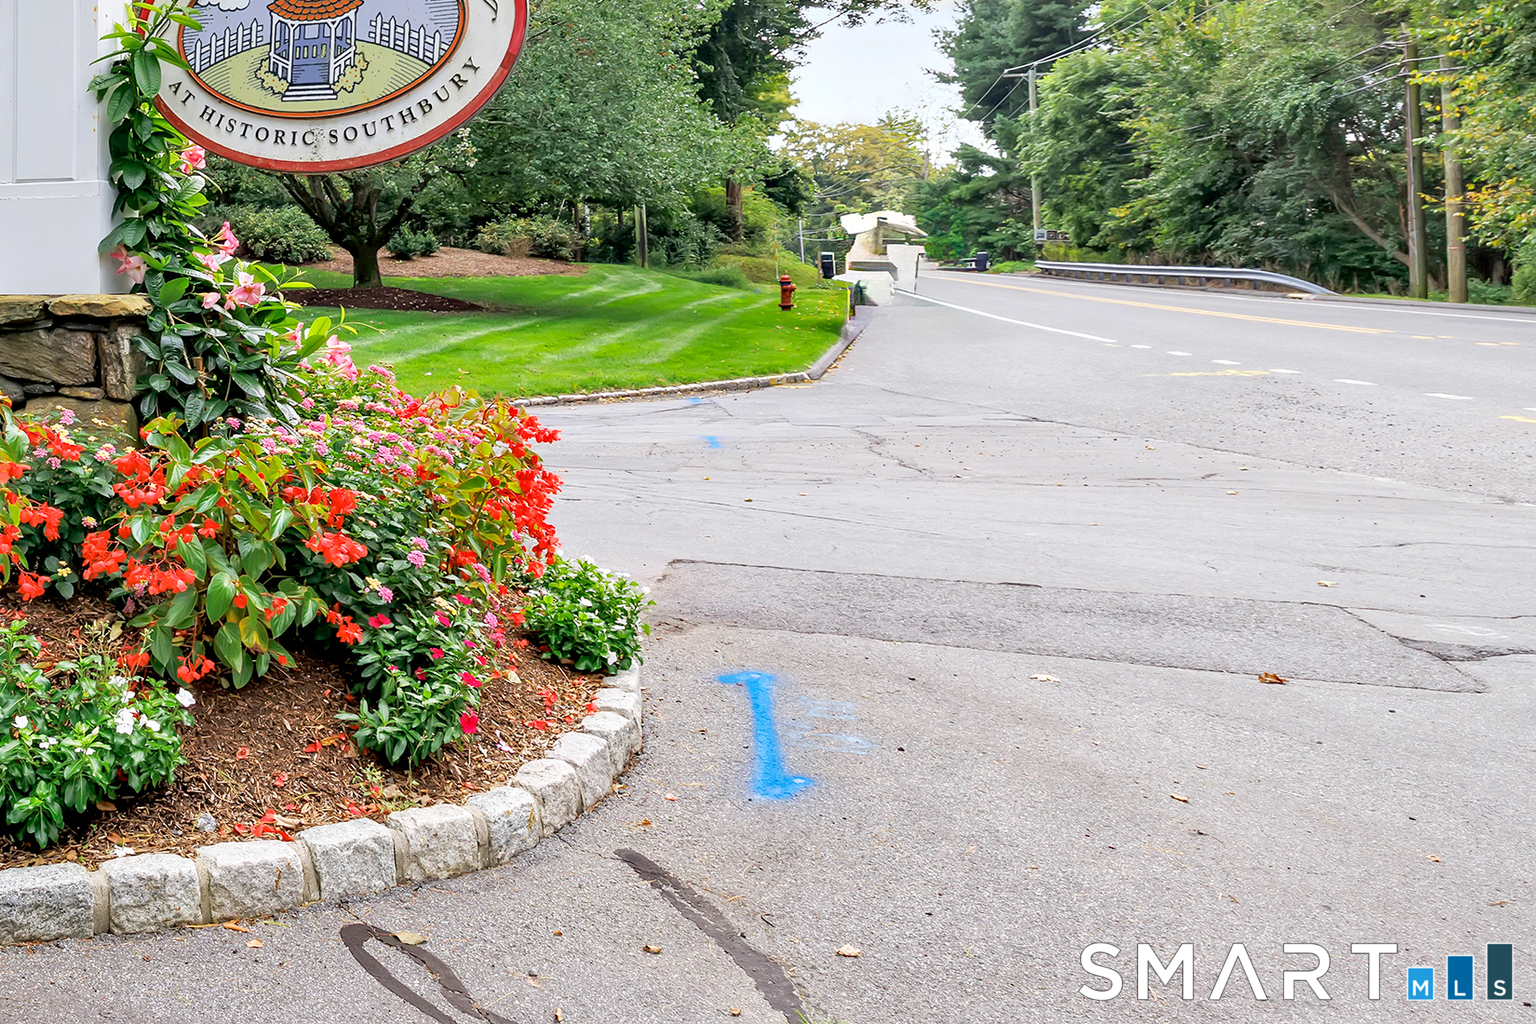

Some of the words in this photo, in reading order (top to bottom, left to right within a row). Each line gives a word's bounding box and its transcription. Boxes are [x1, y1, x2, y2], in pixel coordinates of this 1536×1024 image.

[168, 81, 195, 106] AT
[199, 107, 317, 146] HISTORIC
[328, 56, 481, 145] SOUTHBURY
